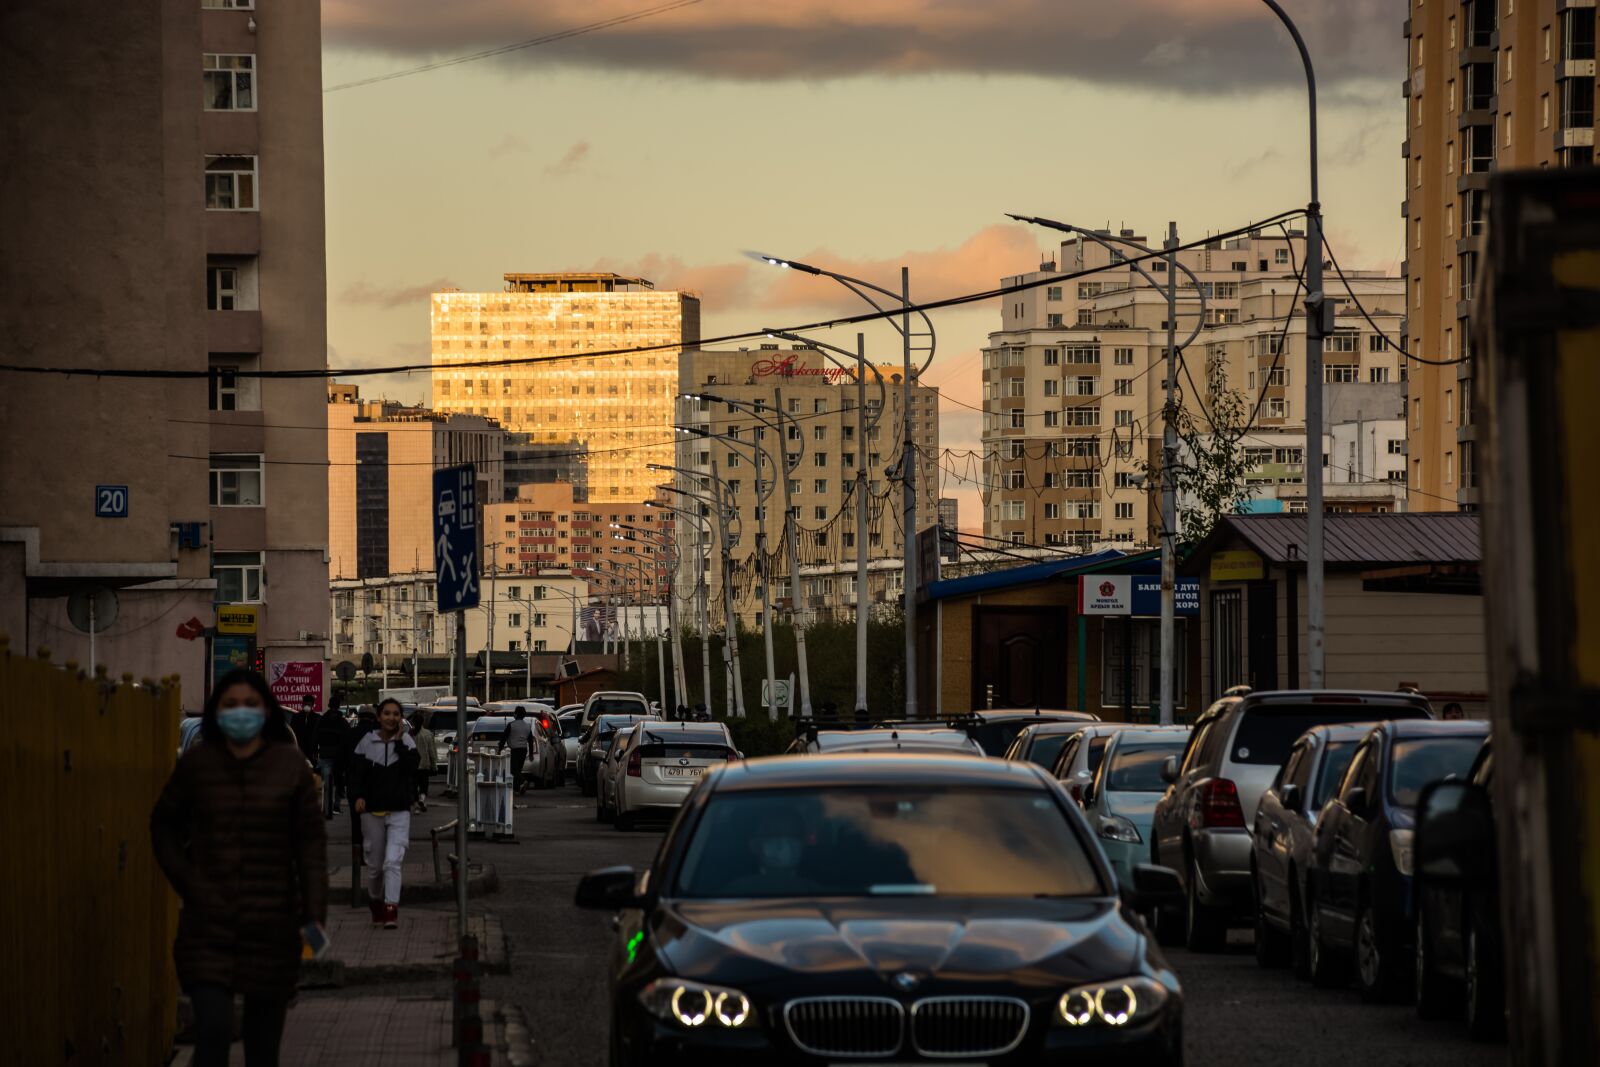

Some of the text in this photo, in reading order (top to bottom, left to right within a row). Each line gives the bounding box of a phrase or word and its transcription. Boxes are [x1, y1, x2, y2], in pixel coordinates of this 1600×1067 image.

[100, 490, 124, 513] 20
[272, 684, 321, 693] ГОО САЙХАН
